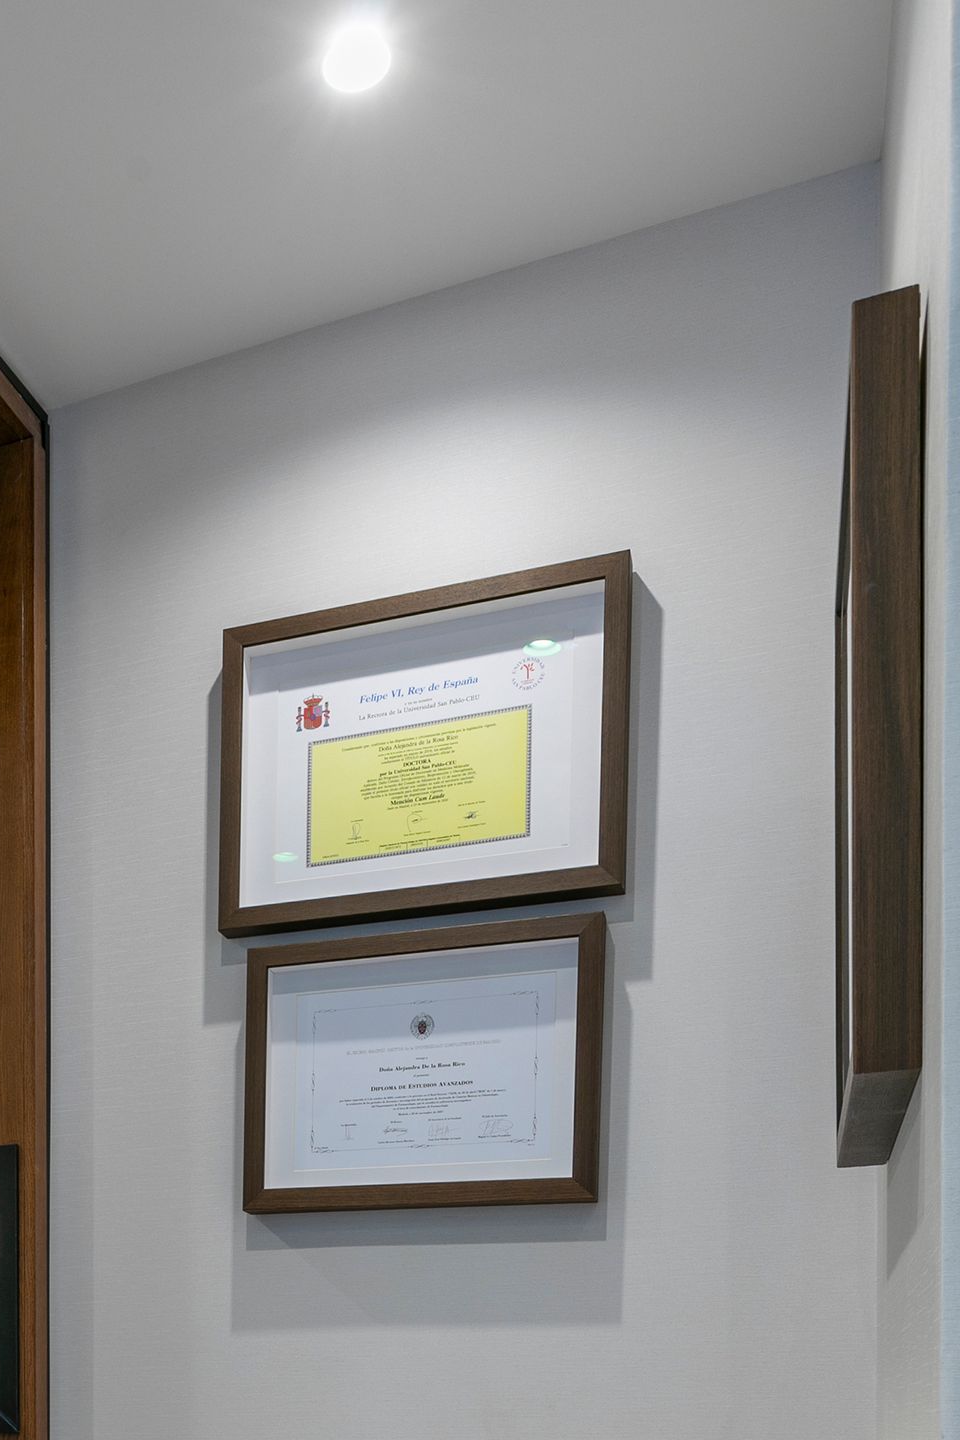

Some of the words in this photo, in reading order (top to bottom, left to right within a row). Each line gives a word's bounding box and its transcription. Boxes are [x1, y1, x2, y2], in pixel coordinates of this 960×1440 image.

[359, 693, 389, 704] Felipe
[391, 688, 404, 698] VI,
[407, 686, 425, 696] Rey
[428, 683, 440, 692] de
[443, 676, 479, 689] España
[404, 703, 436, 713] Universidad
[390, 798, 414, 806] Mención
[395, 1065, 420, 1073] Alejandra
